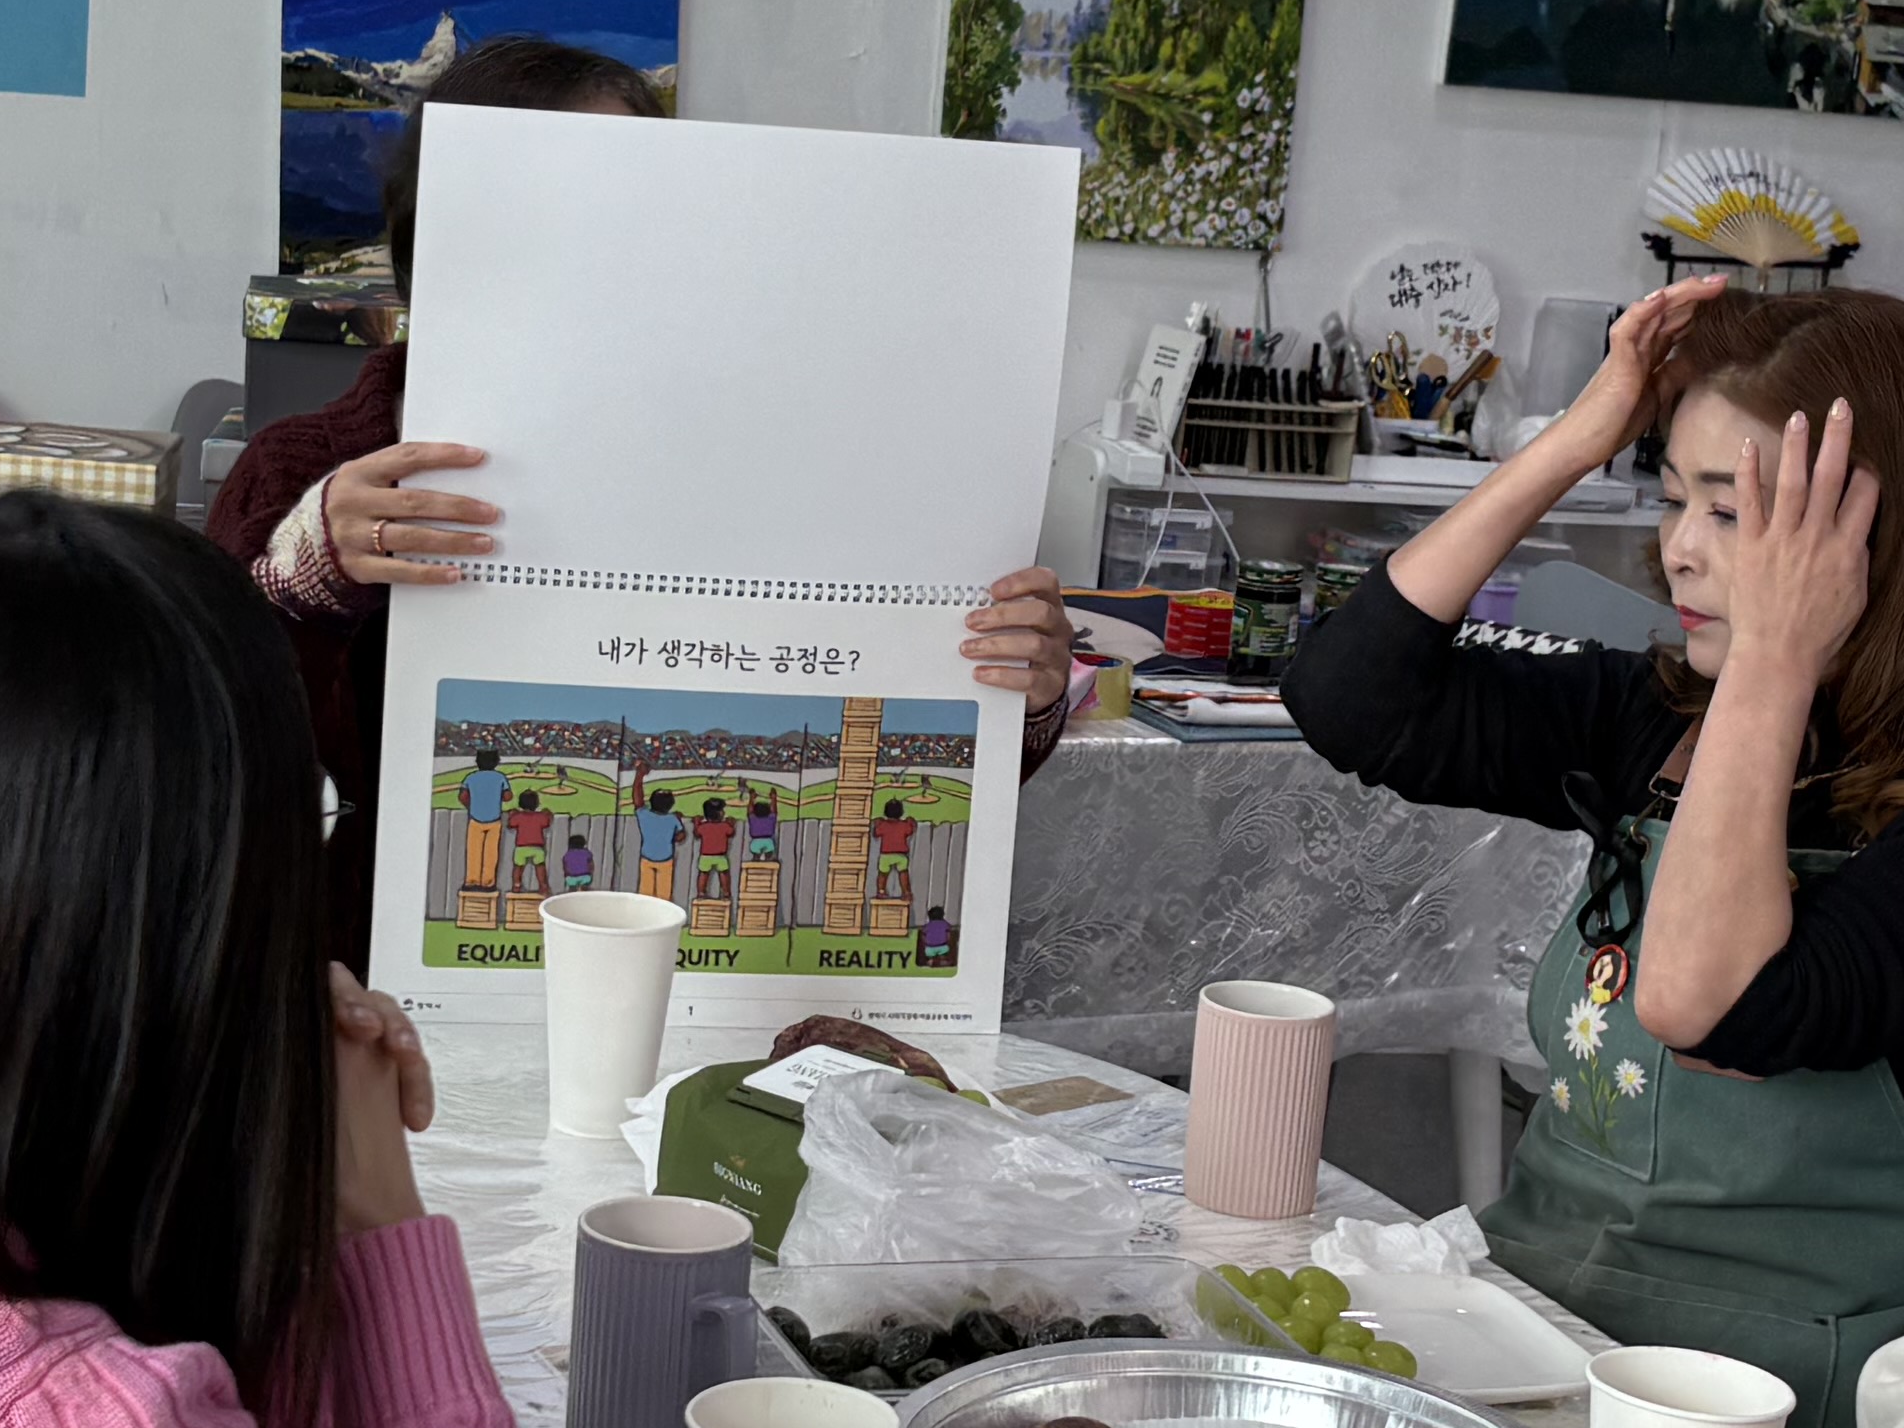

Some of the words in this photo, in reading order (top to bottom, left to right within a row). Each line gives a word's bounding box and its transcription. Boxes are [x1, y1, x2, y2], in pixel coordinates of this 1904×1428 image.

[598, 635, 649, 666] 내가
[657, 638, 761, 672] 생각하는
[769, 645, 861, 676] 공정은?
[457, 942, 540, 964] EQUALI
[675, 948, 741, 970] QUITY
[818, 948, 913, 970] REALITY
